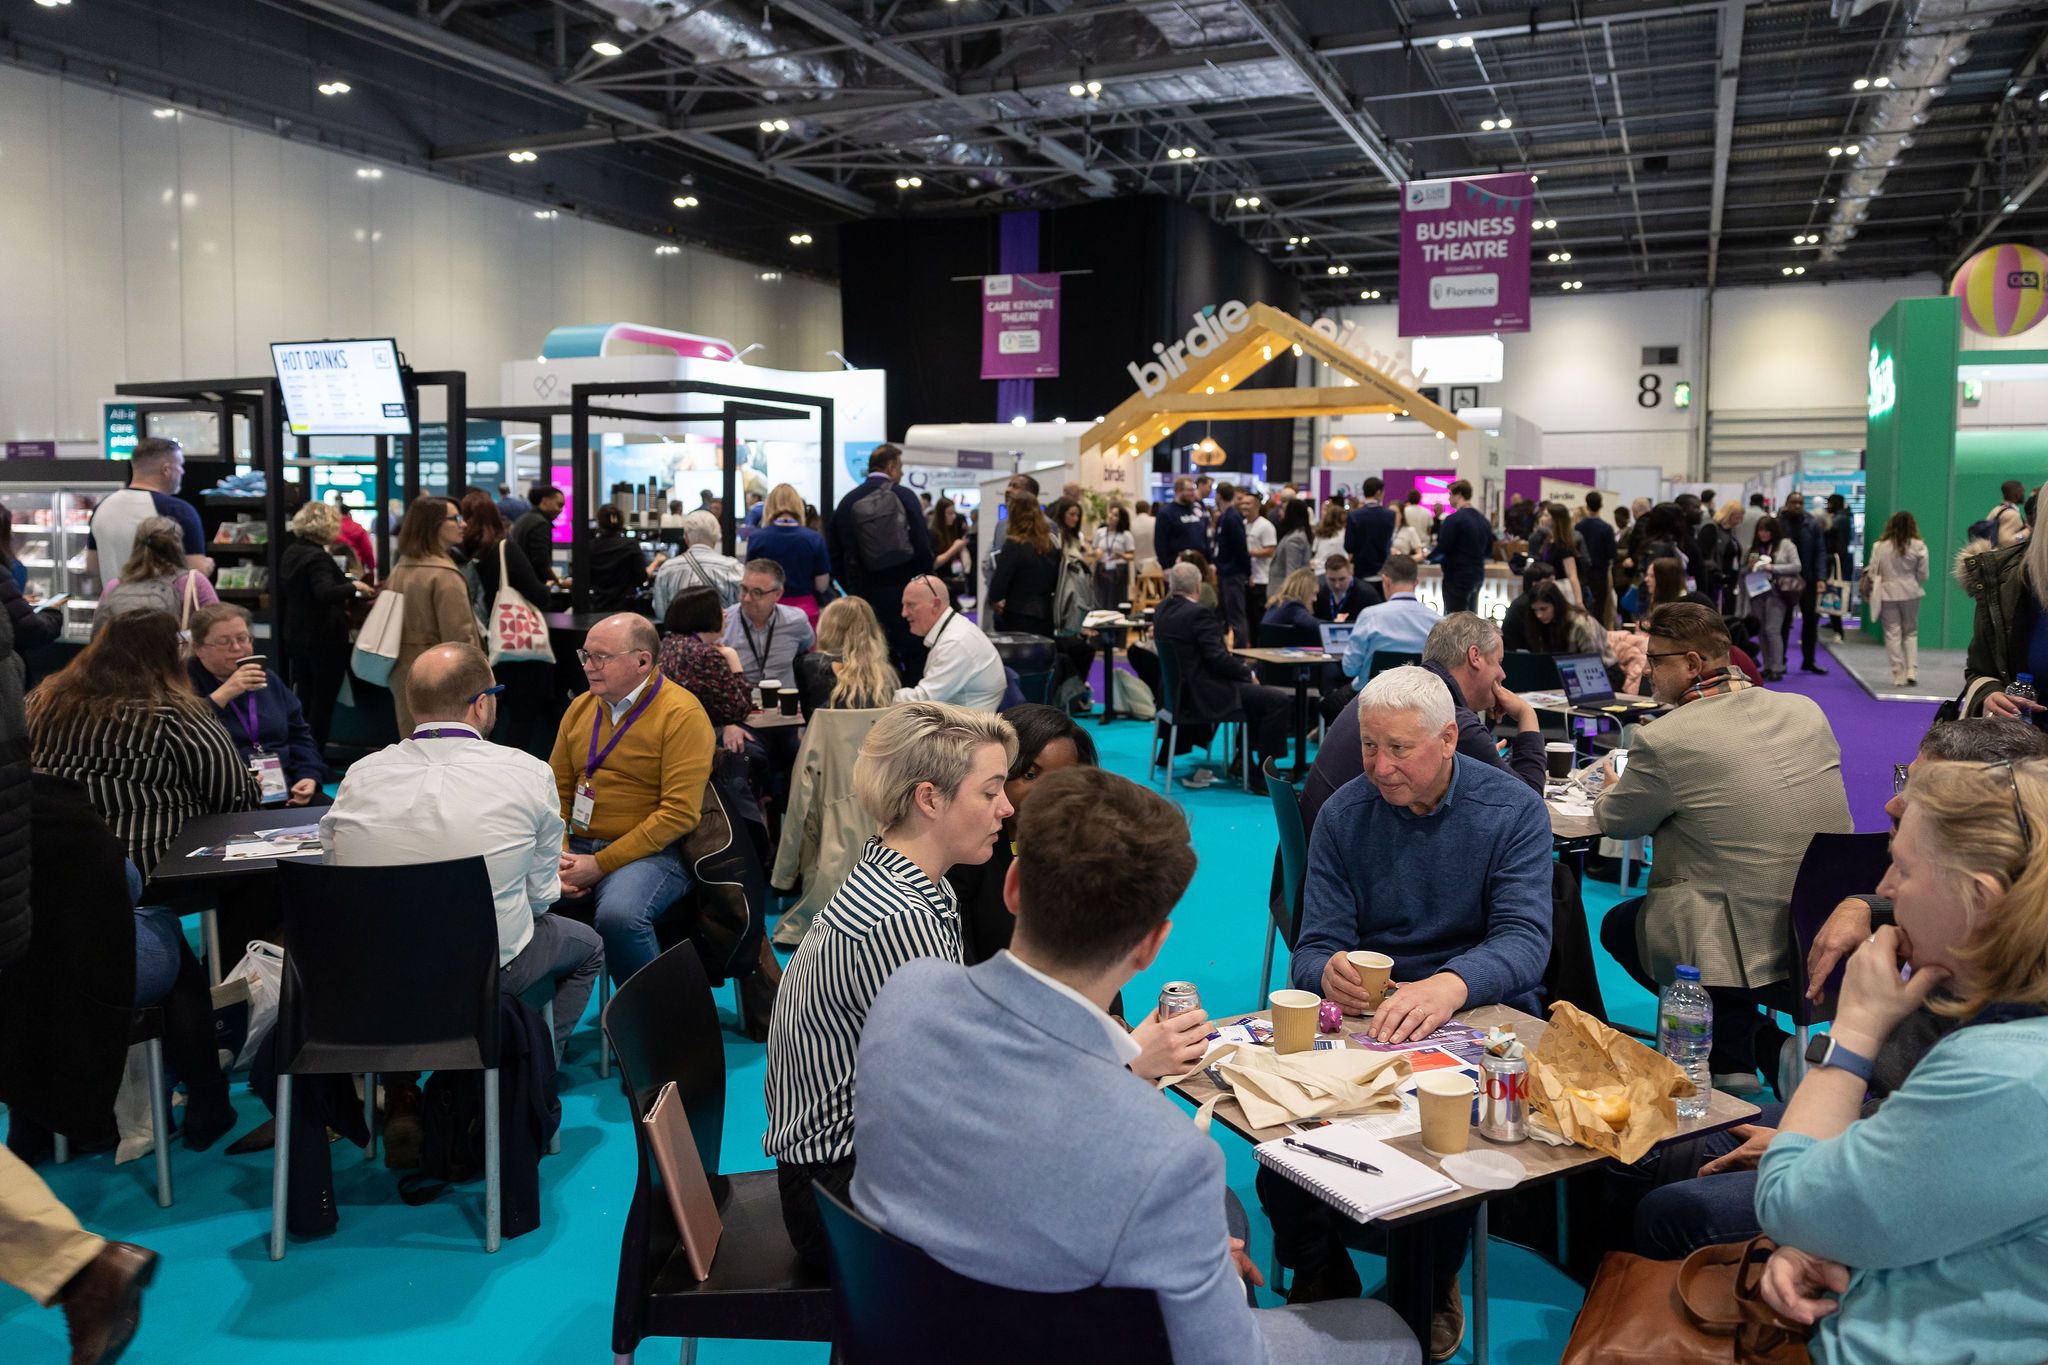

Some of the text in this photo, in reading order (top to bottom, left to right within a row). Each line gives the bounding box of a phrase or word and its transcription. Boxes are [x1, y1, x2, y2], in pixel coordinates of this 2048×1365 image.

[1416, 216, 1516, 242] BUSINESS
[1422, 240, 1509, 263] THEATRE
[1446, 284, 1495, 298] Florence
[987, 299, 1054, 312] CARE KEYNOTE
[1001, 311, 1039, 323] THEATRE
[280, 349, 348, 370] HOT DRINKS
[1127, 300, 1249, 398] birdie
[1638, 373, 1662, 408] 8
